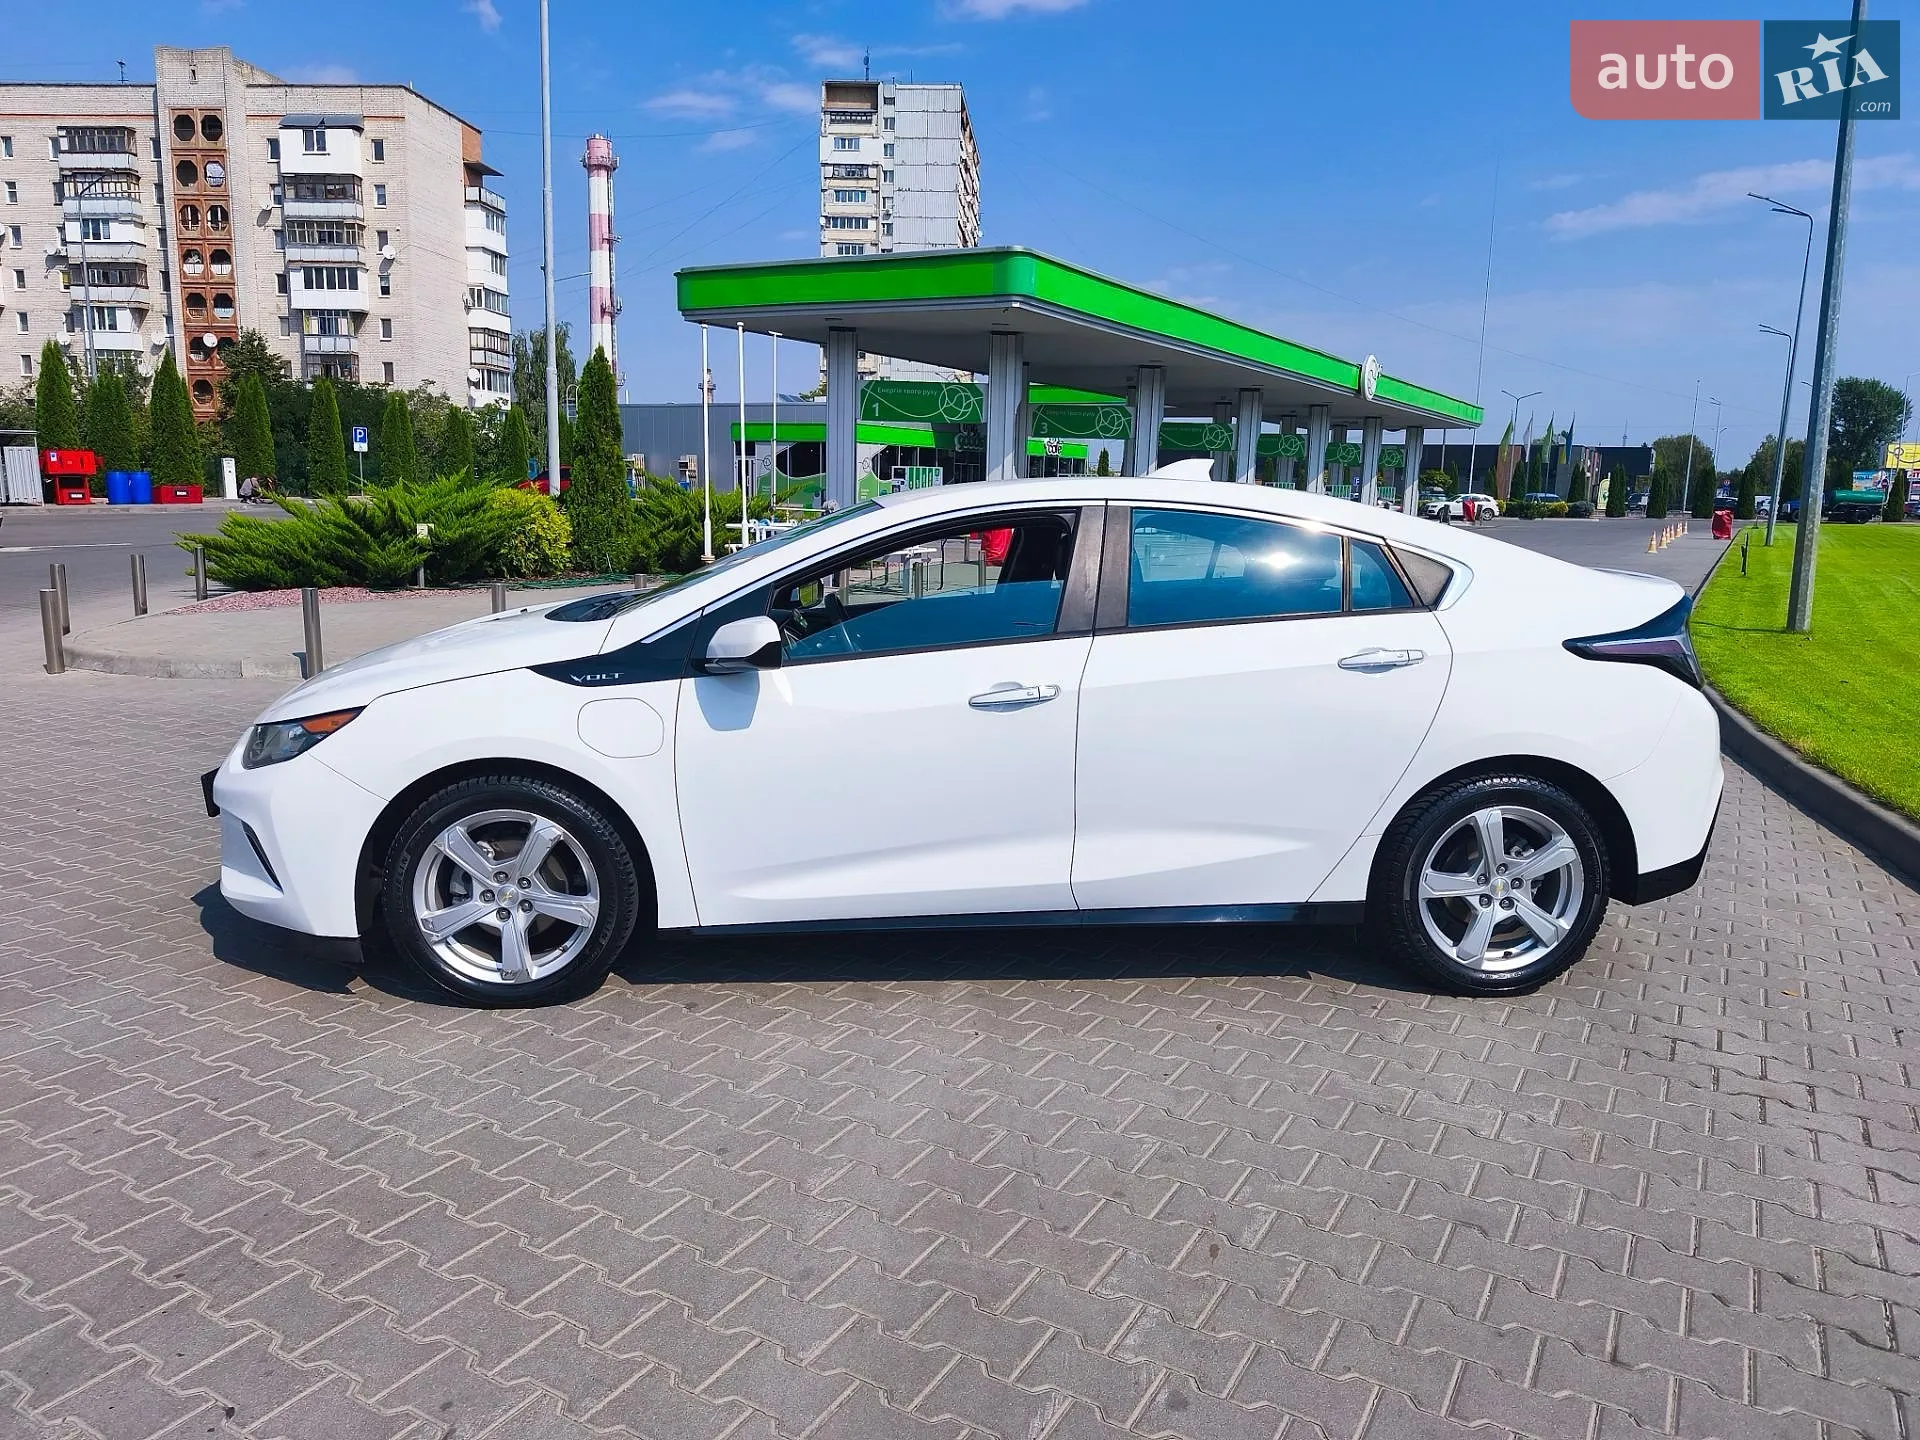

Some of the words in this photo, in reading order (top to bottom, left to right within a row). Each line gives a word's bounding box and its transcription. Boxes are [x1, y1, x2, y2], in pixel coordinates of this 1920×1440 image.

[872, 402, 879, 417] 1
[1040, 422, 1048, 434] 3
[356, 429, 364, 441] P
[569, 672, 624, 683] VOLT
